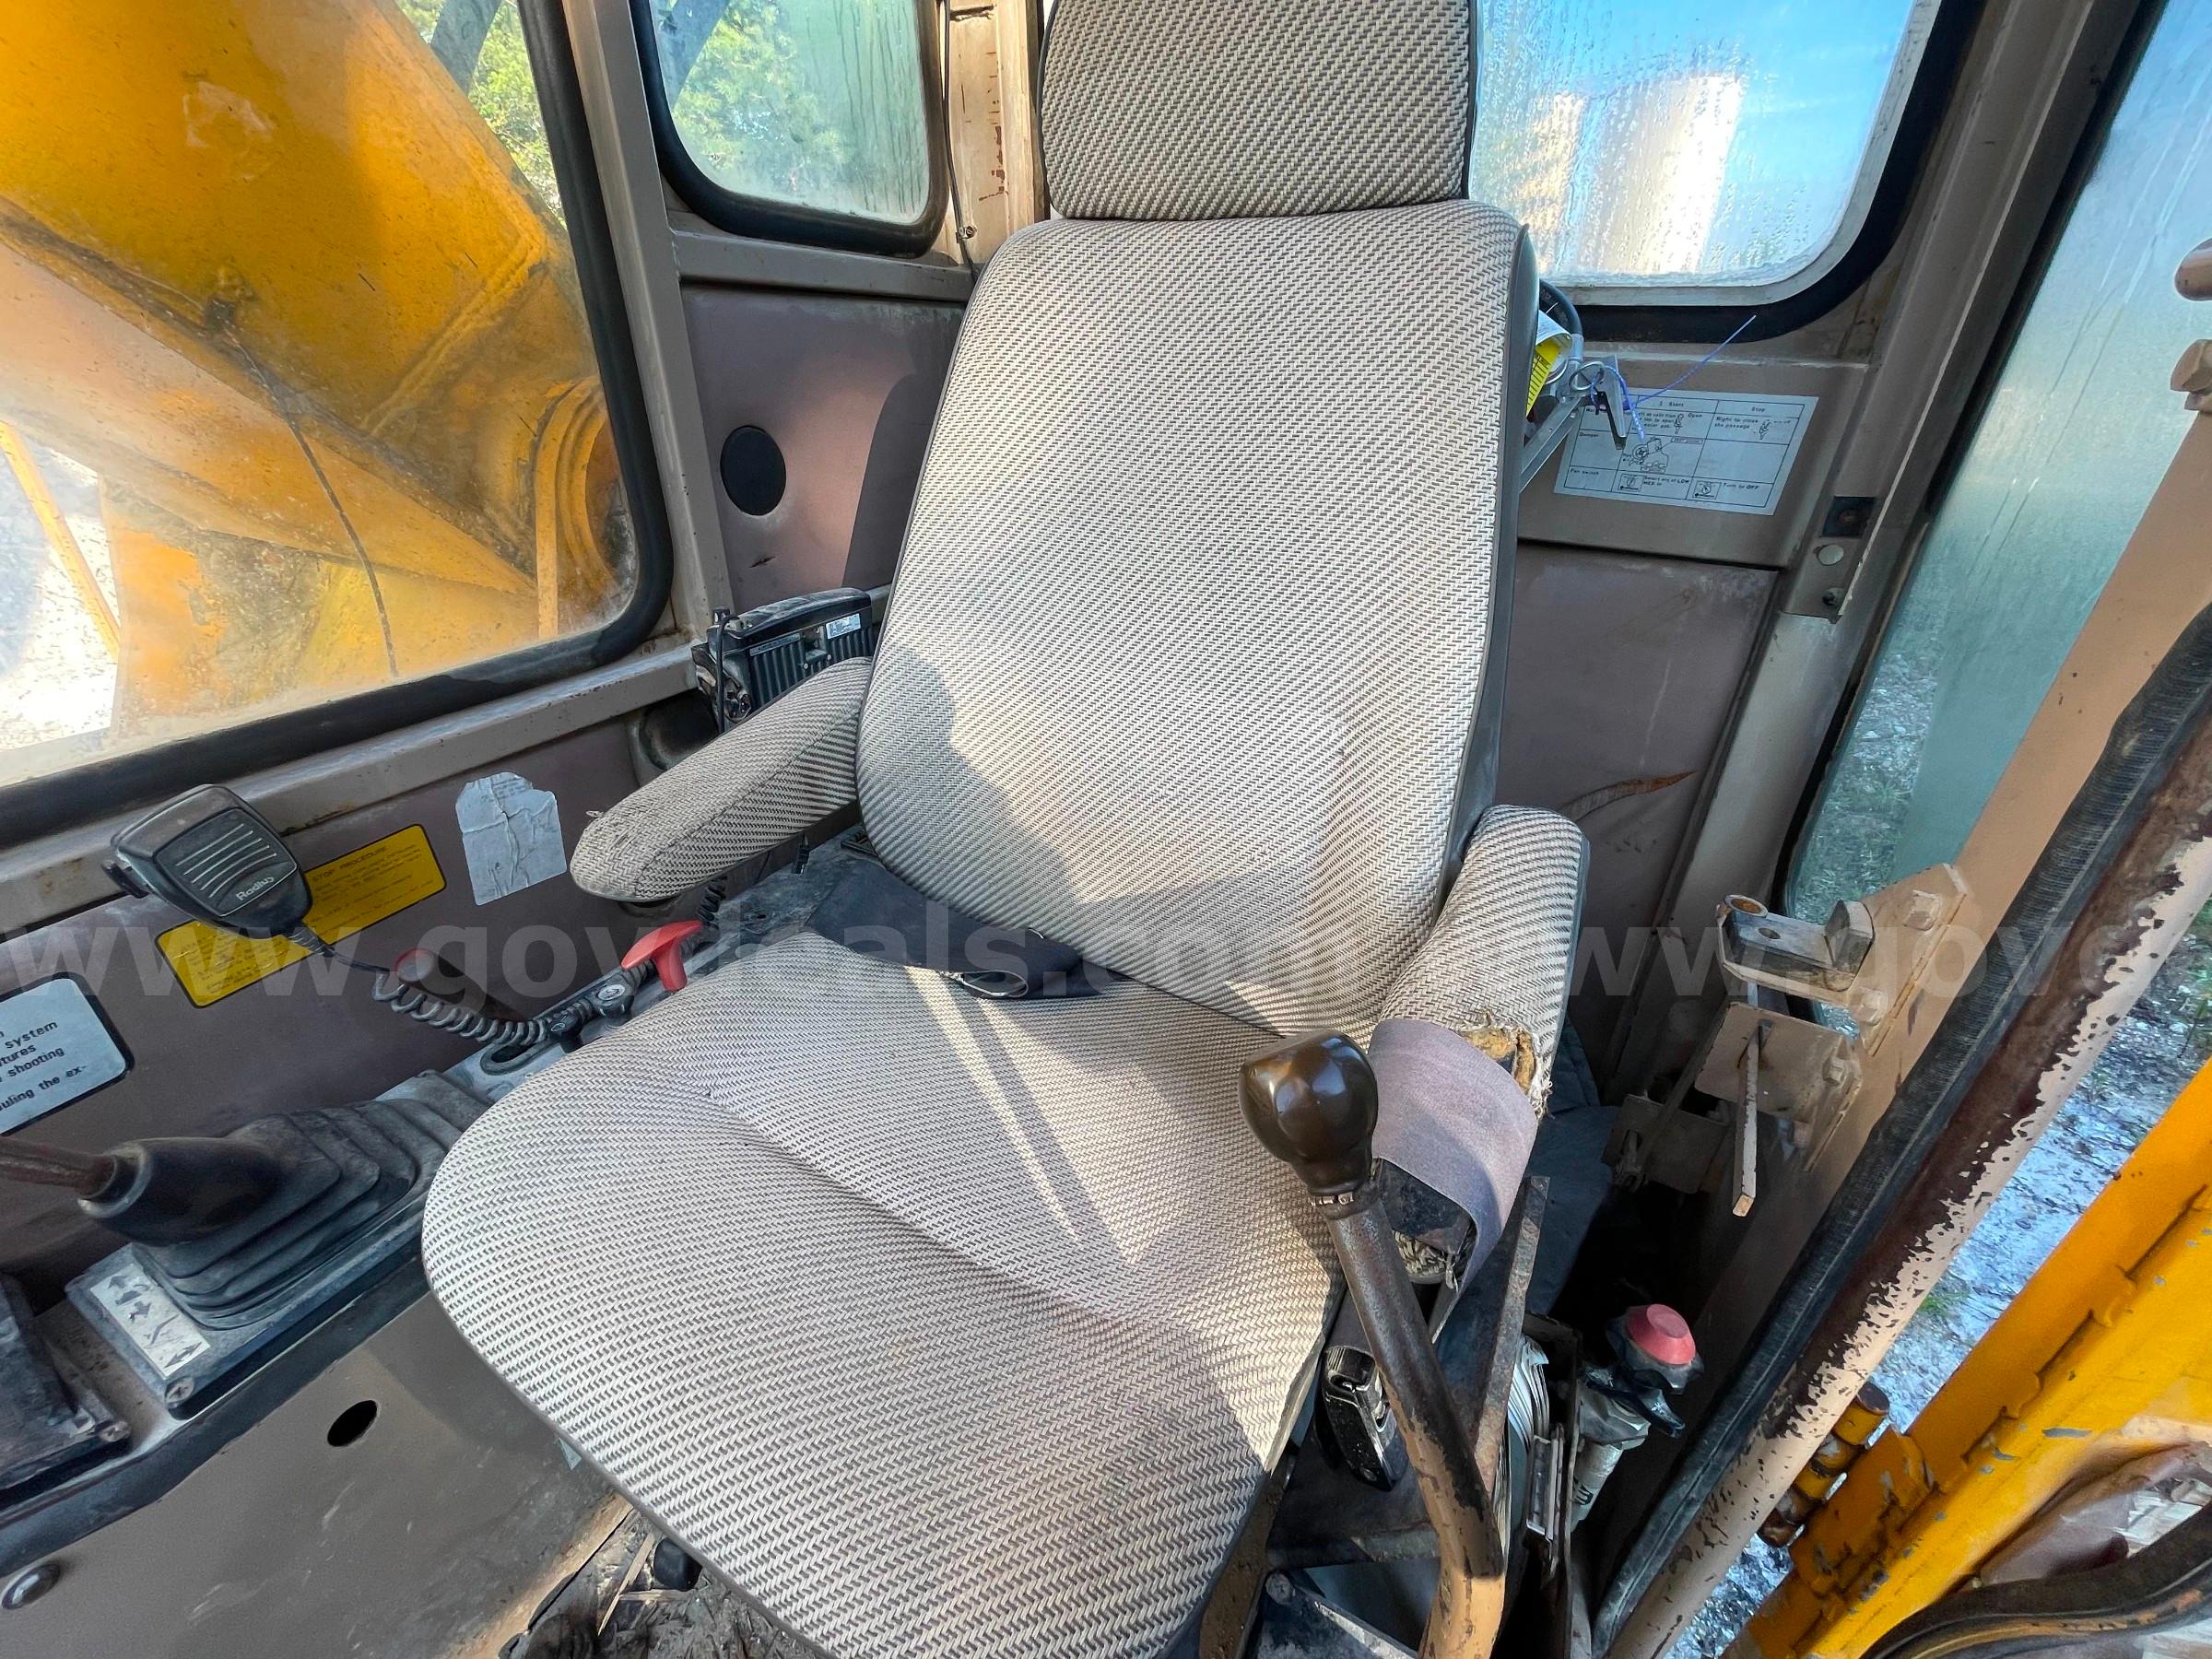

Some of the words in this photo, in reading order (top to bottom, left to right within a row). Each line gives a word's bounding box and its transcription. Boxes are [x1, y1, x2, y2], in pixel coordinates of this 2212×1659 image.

[236, 877, 275, 901] Radius
[5, 1021, 59, 1049] system
[7, 1047, 65, 1077] shooting
[38, 1077, 61, 1090] the
